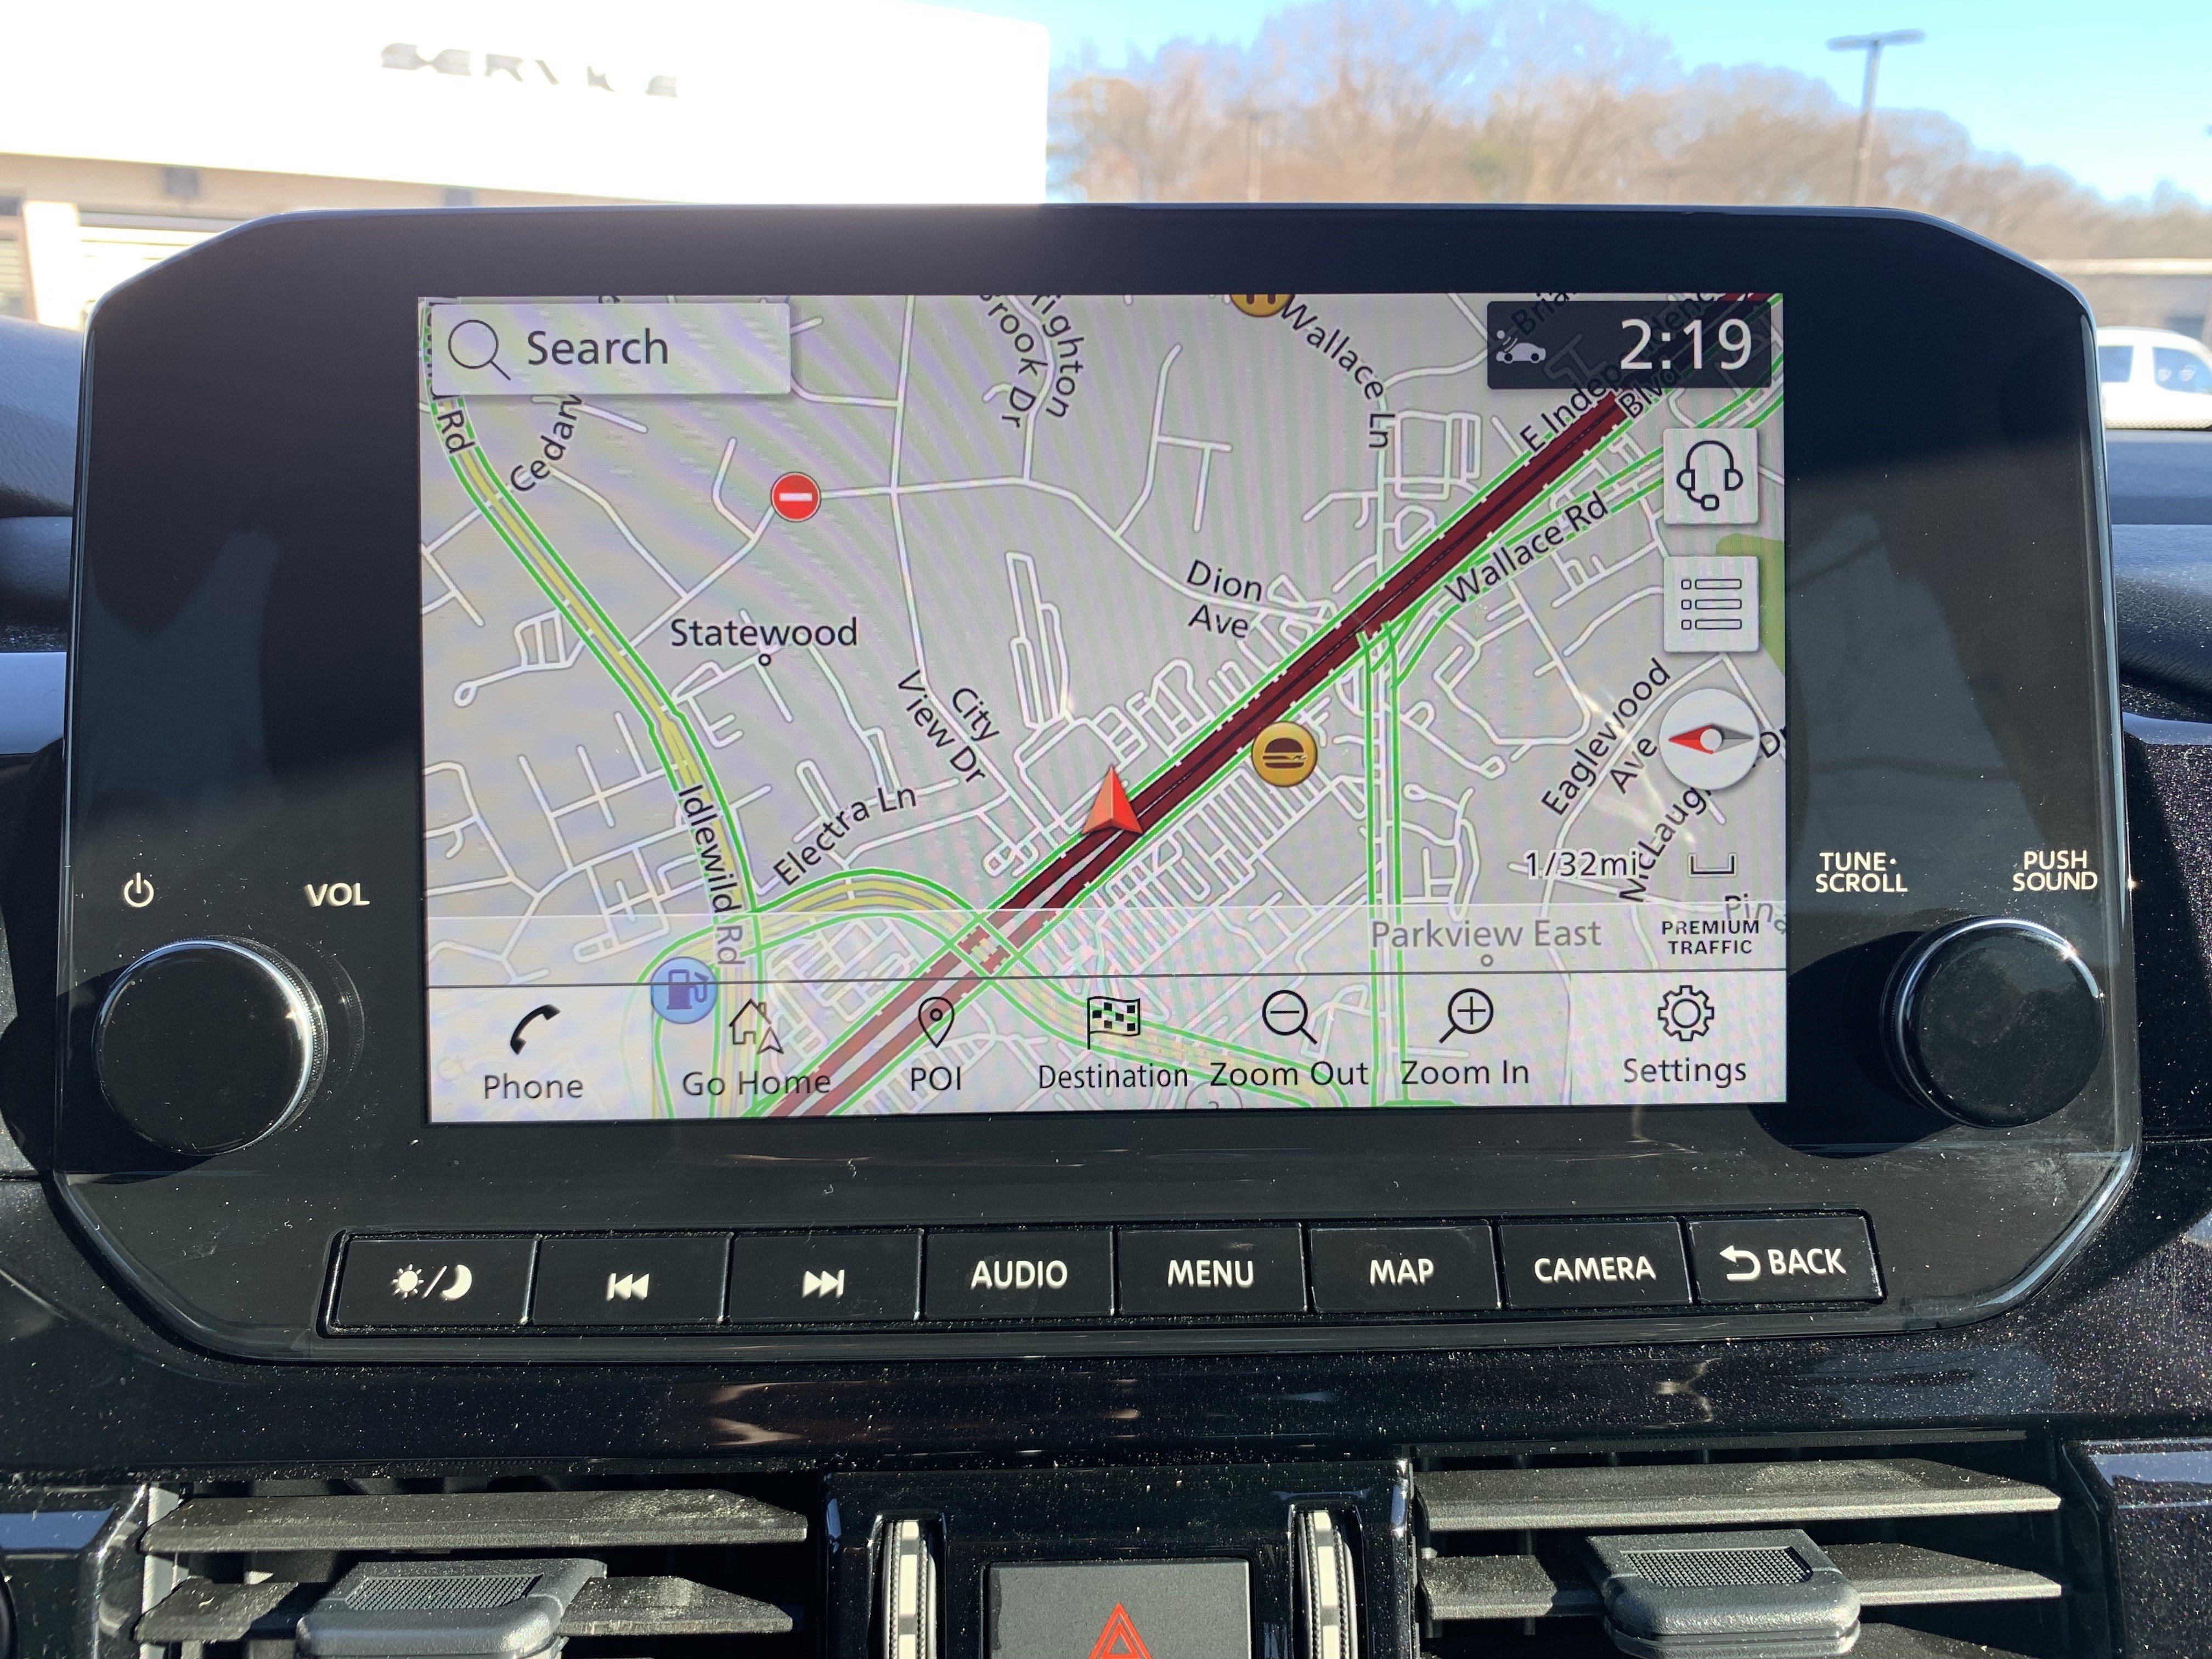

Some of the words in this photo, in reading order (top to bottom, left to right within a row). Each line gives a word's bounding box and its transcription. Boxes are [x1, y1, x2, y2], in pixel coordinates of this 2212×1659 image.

[527, 328, 668, 366] Search
[980, 295, 1048, 376] rook
[1620, 318, 1751, 370] 2:19
[1280, 294, 1384, 400] Wallace
[1369, 413, 1395, 448] Ln
[1002, 386, 1037, 428] Dr
[437, 410, 476, 454] Rd
[1520, 426, 1545, 452] E
[1445, 525, 1564, 603] Wallace
[1565, 490, 1609, 532] Rd
[1187, 560, 1262, 601] Dion
[671, 617, 857, 647] Statewood
[1188, 605, 1249, 638] Ave
[897, 669, 955, 748] View
[950, 746, 986, 782] Dr
[952, 687, 999, 742] City
[1541, 658, 1671, 815] Eaglewood
[1610, 737, 1657, 794] Ave
[773, 800, 870, 887] Electra
[877, 787, 916, 812] Ln
[1618, 787, 1712, 902] McLaug
[1526, 850, 1636, 876] 1/32mi
[2023, 850, 2087, 870] PUSH
[679, 785, 741, 913] Idlewild
[716, 925, 746, 965] Rd
[1815, 873, 1908, 893] SCROLL
[2012, 871, 2098, 891] SOUND
[304, 882, 370, 906] VOL
[1373, 919, 1522, 947] Parkview
[1534, 920, 1601, 946] East
[1662, 920, 1759, 934] PREMIUM
[1668, 940, 1753, 955] TRAFFIC
[484, 1074, 584, 1099] Phone
[683, 1071, 725, 1096] Go
[740, 1071, 831, 1095] Home
[911, 1066, 961, 1091] POI
[1040, 1065, 1188, 1088] Destination
[1210, 1062, 1299, 1086] Zoom
[1311, 1061, 1368, 1085] Out
[1401, 1062, 1489, 1085] Zoom
[1503, 1060, 1528, 1084] In
[1624, 1057, 1747, 1088] Settings
[970, 1260, 1068, 1289] AUDIO
[1167, 1260, 1254, 1288] MENU
[1369, 1259, 1434, 1285] MAP
[1534, 1256, 1657, 1282] CAMERA
[1769, 1248, 1846, 1274] BACK
